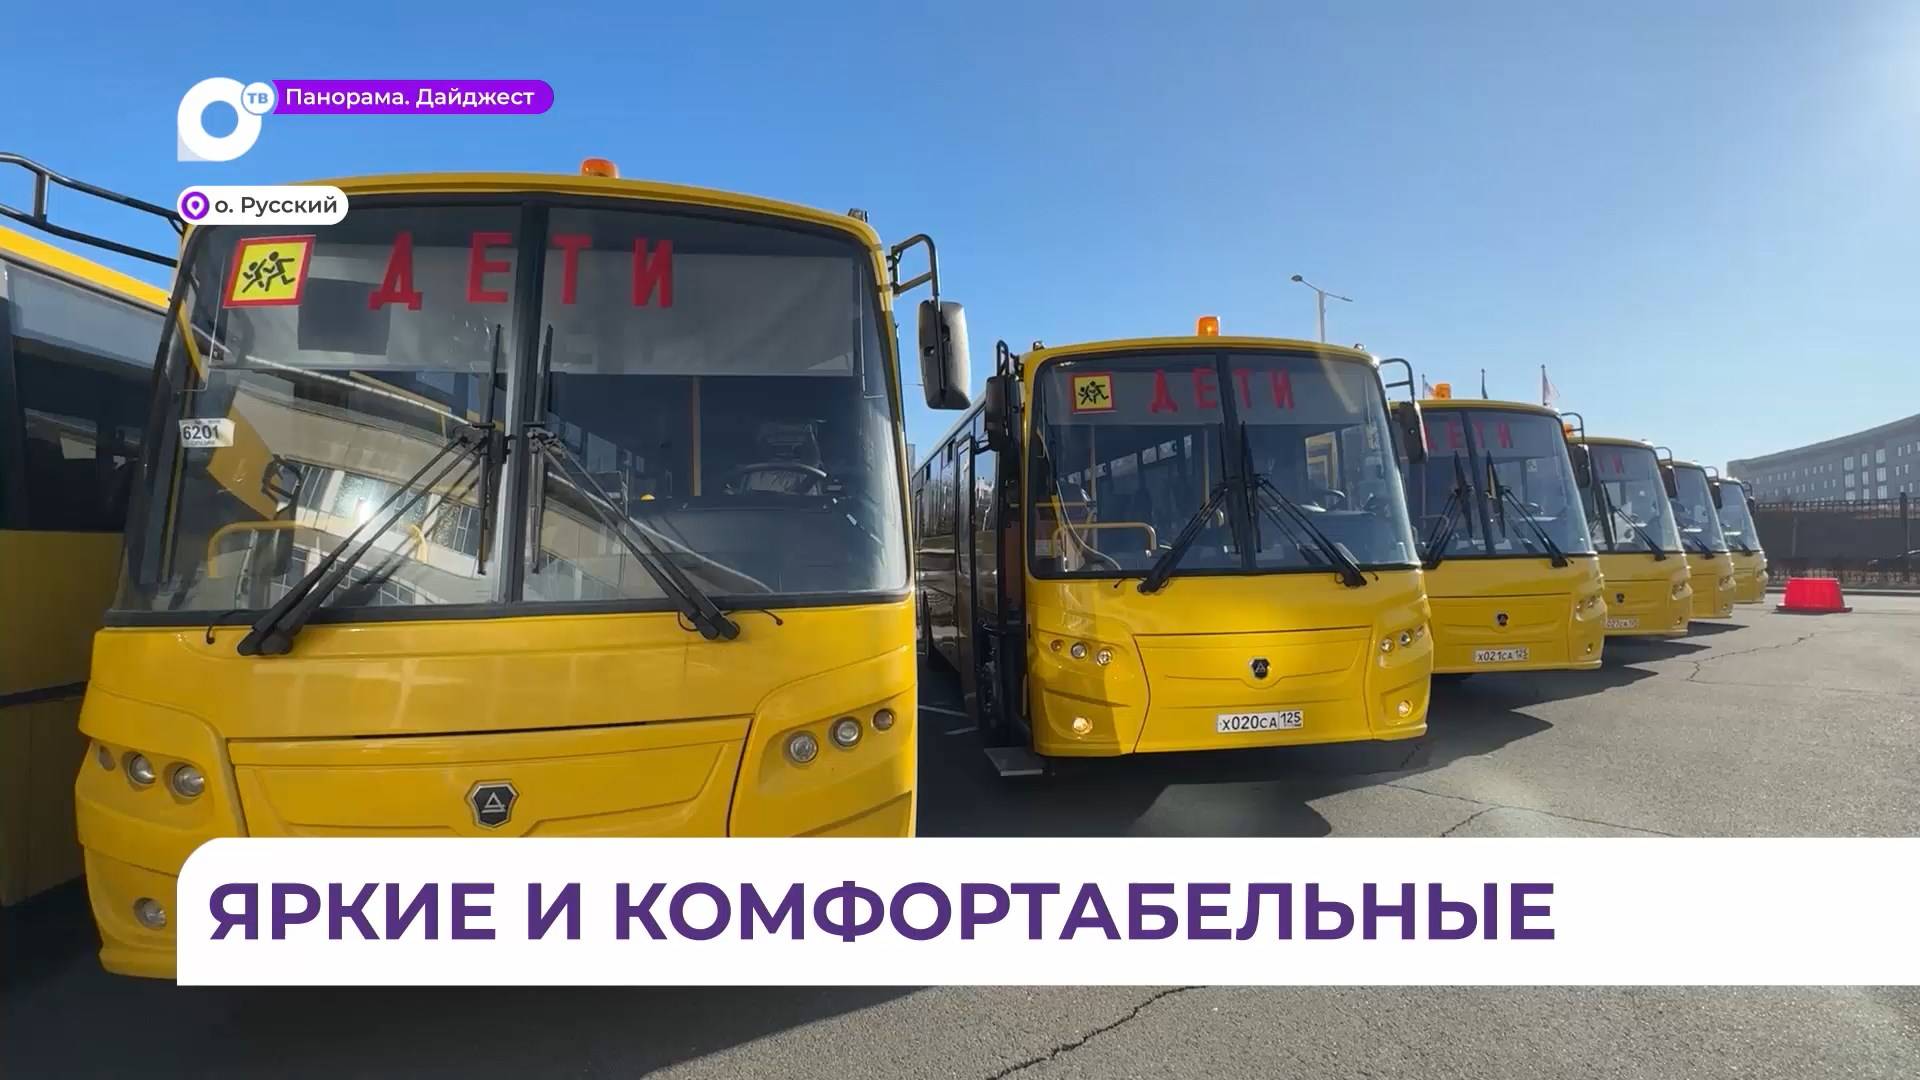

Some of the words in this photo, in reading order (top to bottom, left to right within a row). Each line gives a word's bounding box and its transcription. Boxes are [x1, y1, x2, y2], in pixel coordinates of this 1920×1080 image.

[369, 231, 674, 310] ДЕТИ
[1149, 368, 1295, 413] ДЕТИ
[183, 425, 220, 440] 6201
[1280, 712, 1301, 723] 125
